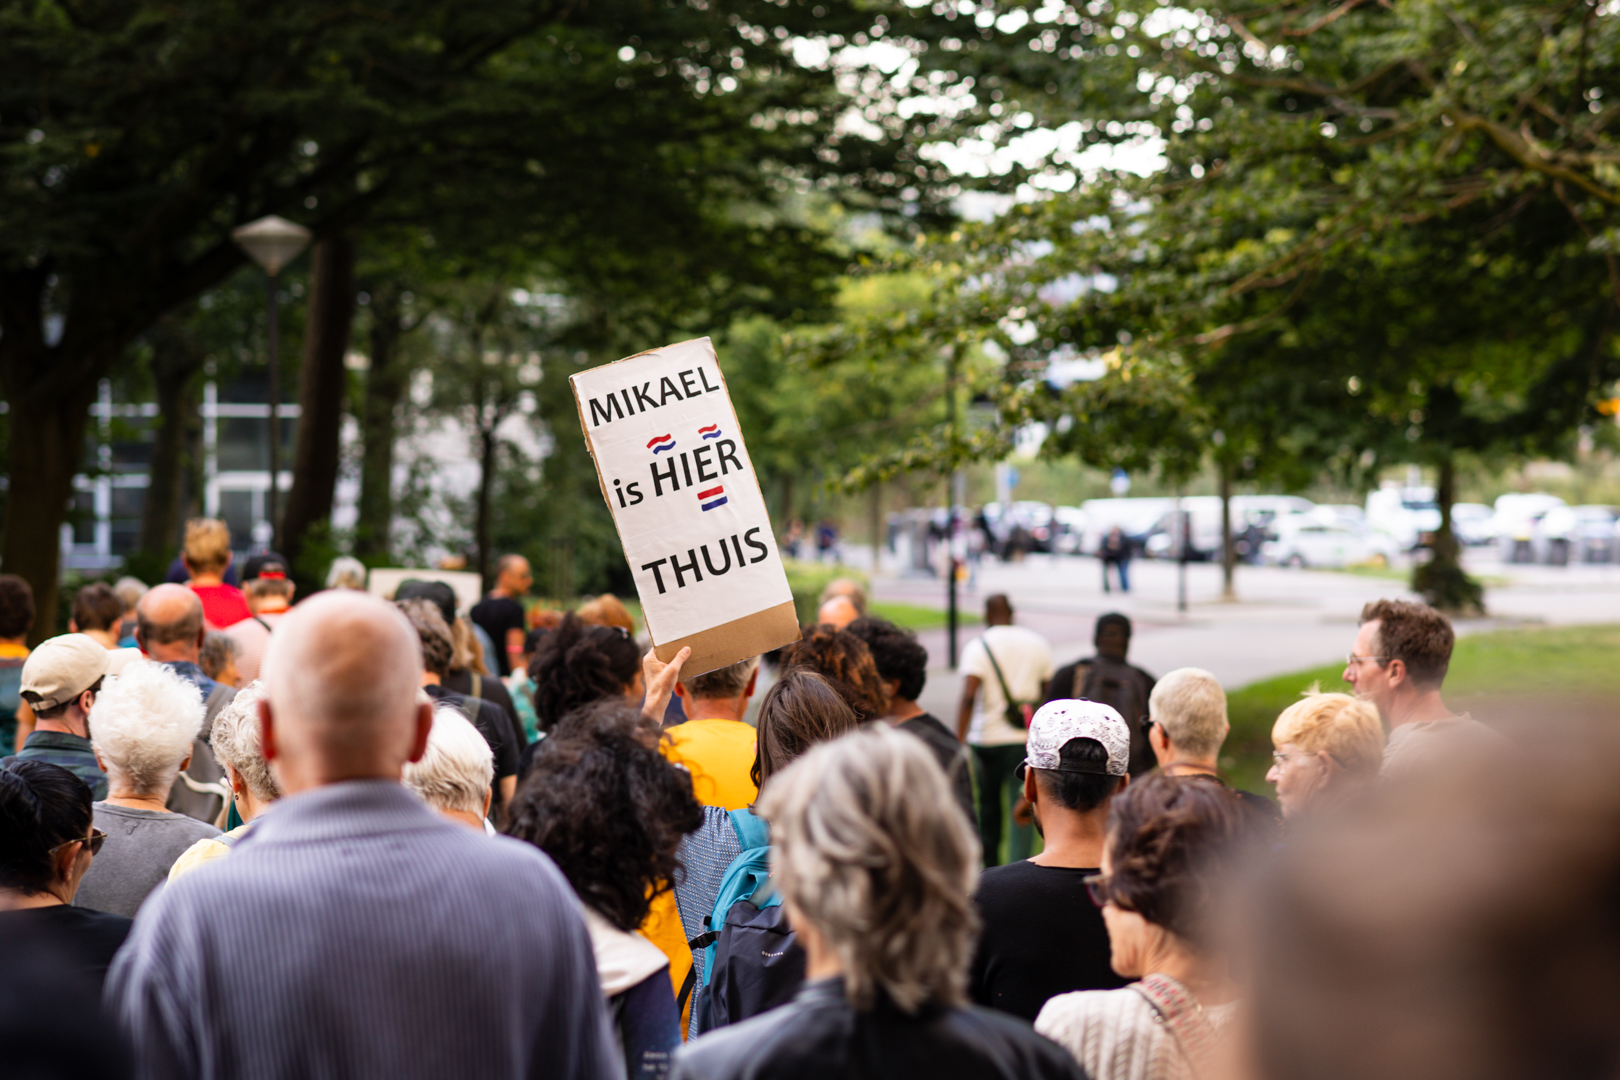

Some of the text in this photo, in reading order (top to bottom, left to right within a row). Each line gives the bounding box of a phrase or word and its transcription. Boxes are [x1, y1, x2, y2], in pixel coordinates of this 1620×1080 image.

[588, 366, 720, 427] MIKAEL
[613, 438, 744, 508] is HIER
[641, 526, 769, 595] THUIS
